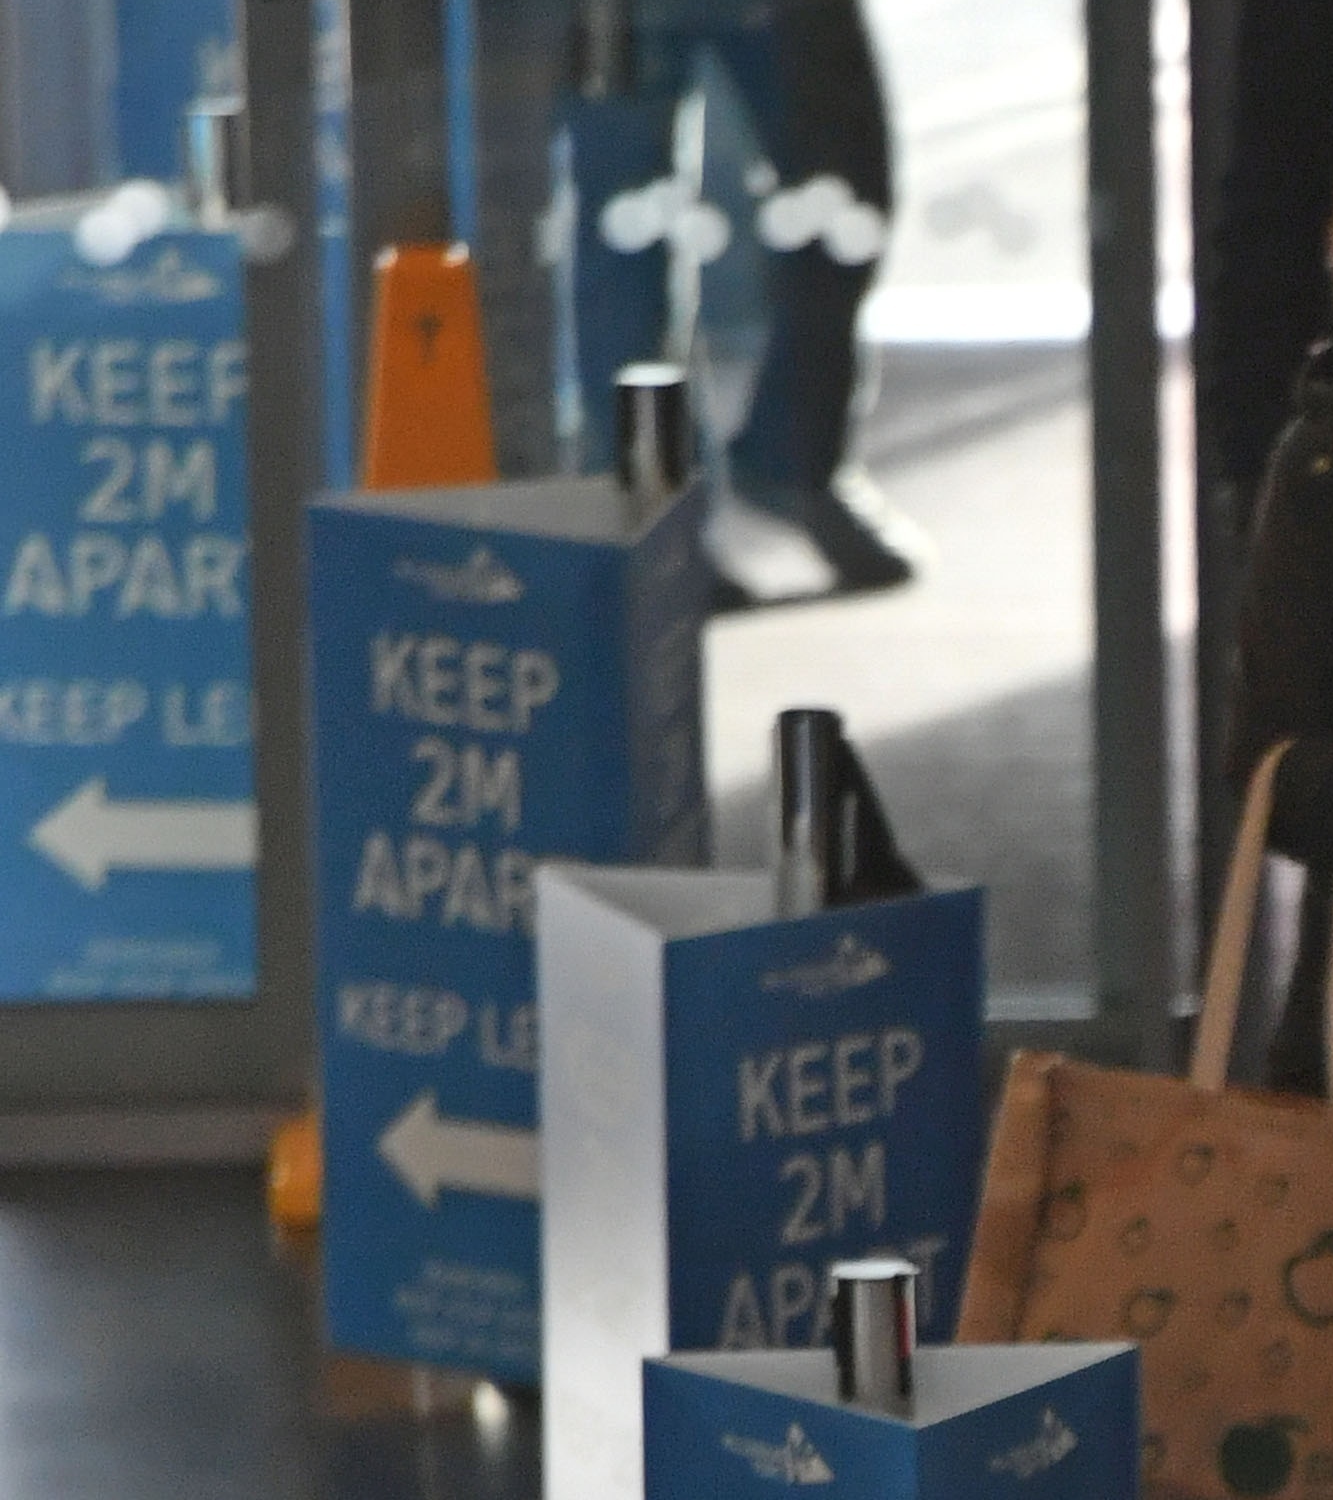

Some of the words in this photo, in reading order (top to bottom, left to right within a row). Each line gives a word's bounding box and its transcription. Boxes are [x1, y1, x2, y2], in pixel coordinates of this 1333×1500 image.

[79, 438, 217, 523] 2M
[4, 532, 246, 620] APAR
[161, 680, 250, 746] LE
[367, 631, 560, 734] KEEP
[407, 735, 523, 833] 2M
[353, 830, 540, 938] APAR
[336, 982, 468, 1055] KEEP
[478, 1003, 538, 1070] LE
[736, 1024, 924, 1142] KEEP
[778, 1143, 887, 1246] 2M
[719, 1234, 948, 1350] APT
